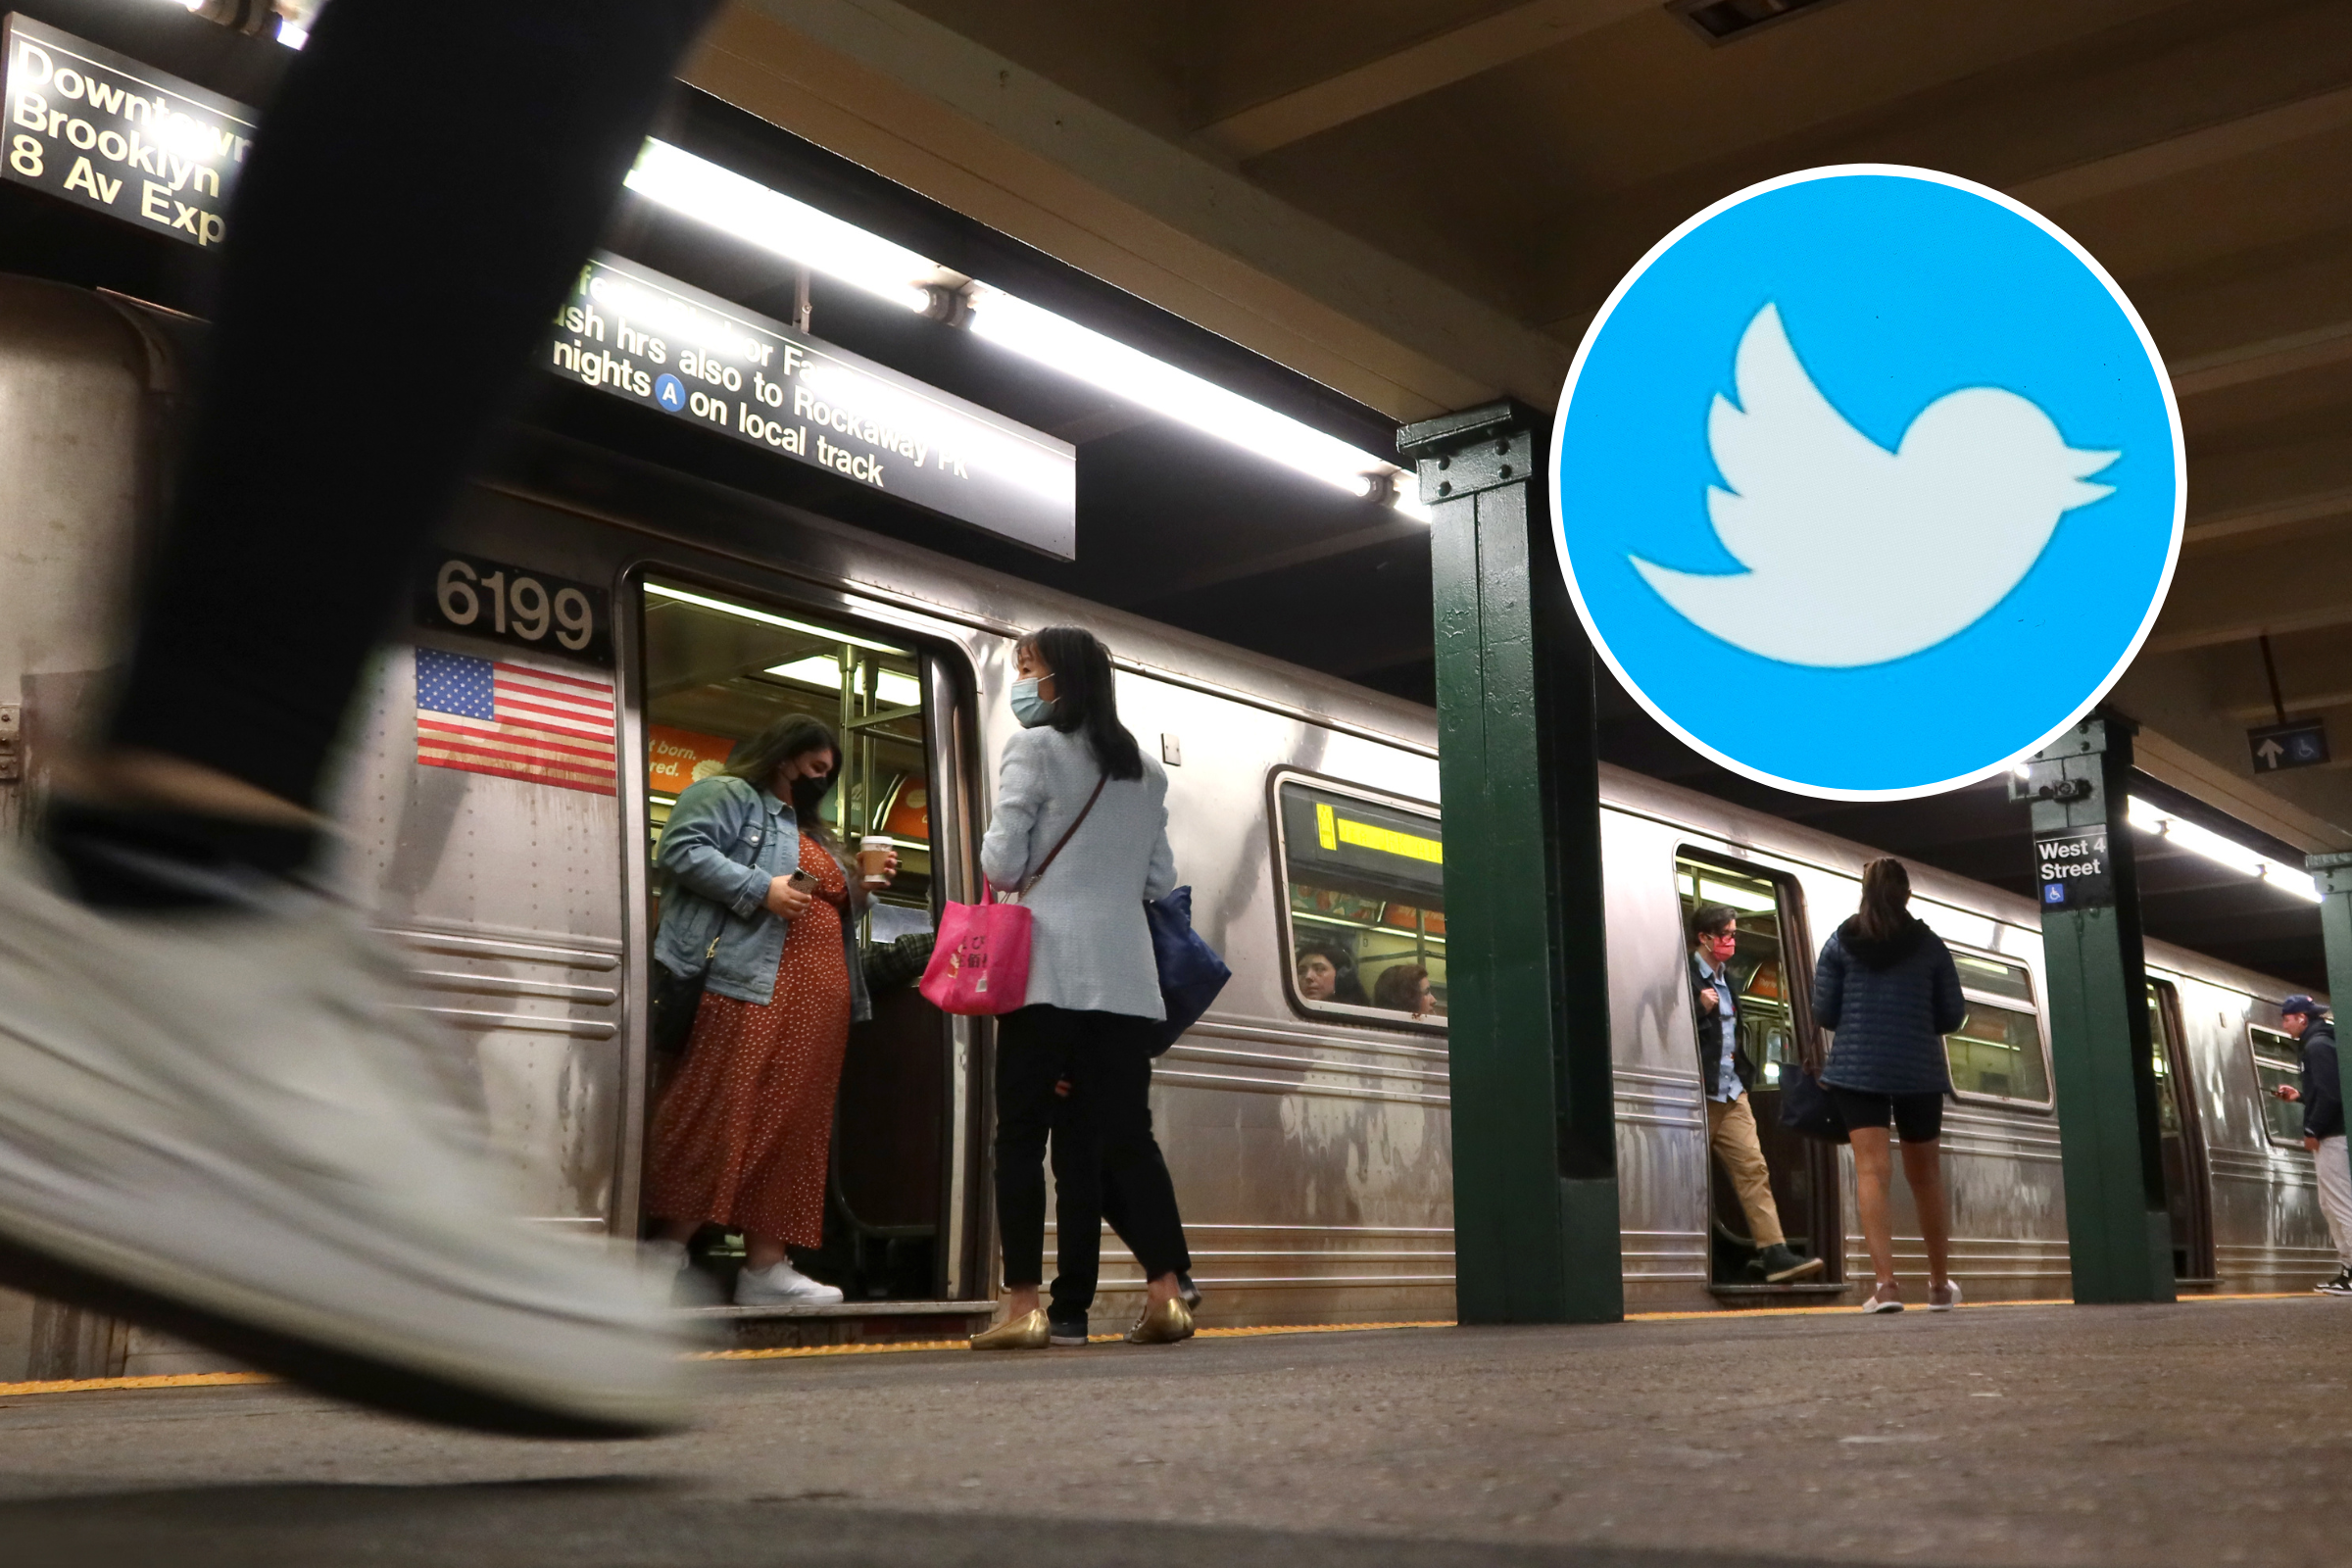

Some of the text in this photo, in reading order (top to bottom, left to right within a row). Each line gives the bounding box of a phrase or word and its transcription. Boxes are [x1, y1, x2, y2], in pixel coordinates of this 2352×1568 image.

[10, 134, 226, 246] 8 Av Exp
[13, 90, 220, 198] Brooklyn
[554, 339, 884, 487] nights A on local track
[617, 317, 666, 364] hrs
[678, 350, 742, 392] also
[754, 371, 783, 408] to
[794, 377, 929, 467] Rockaway
[436, 560, 593, 651] 6199
[656, 741, 697, 760] born.
[2038, 837, 2106, 860] West 4
[2041, 858, 2101, 880] Street
